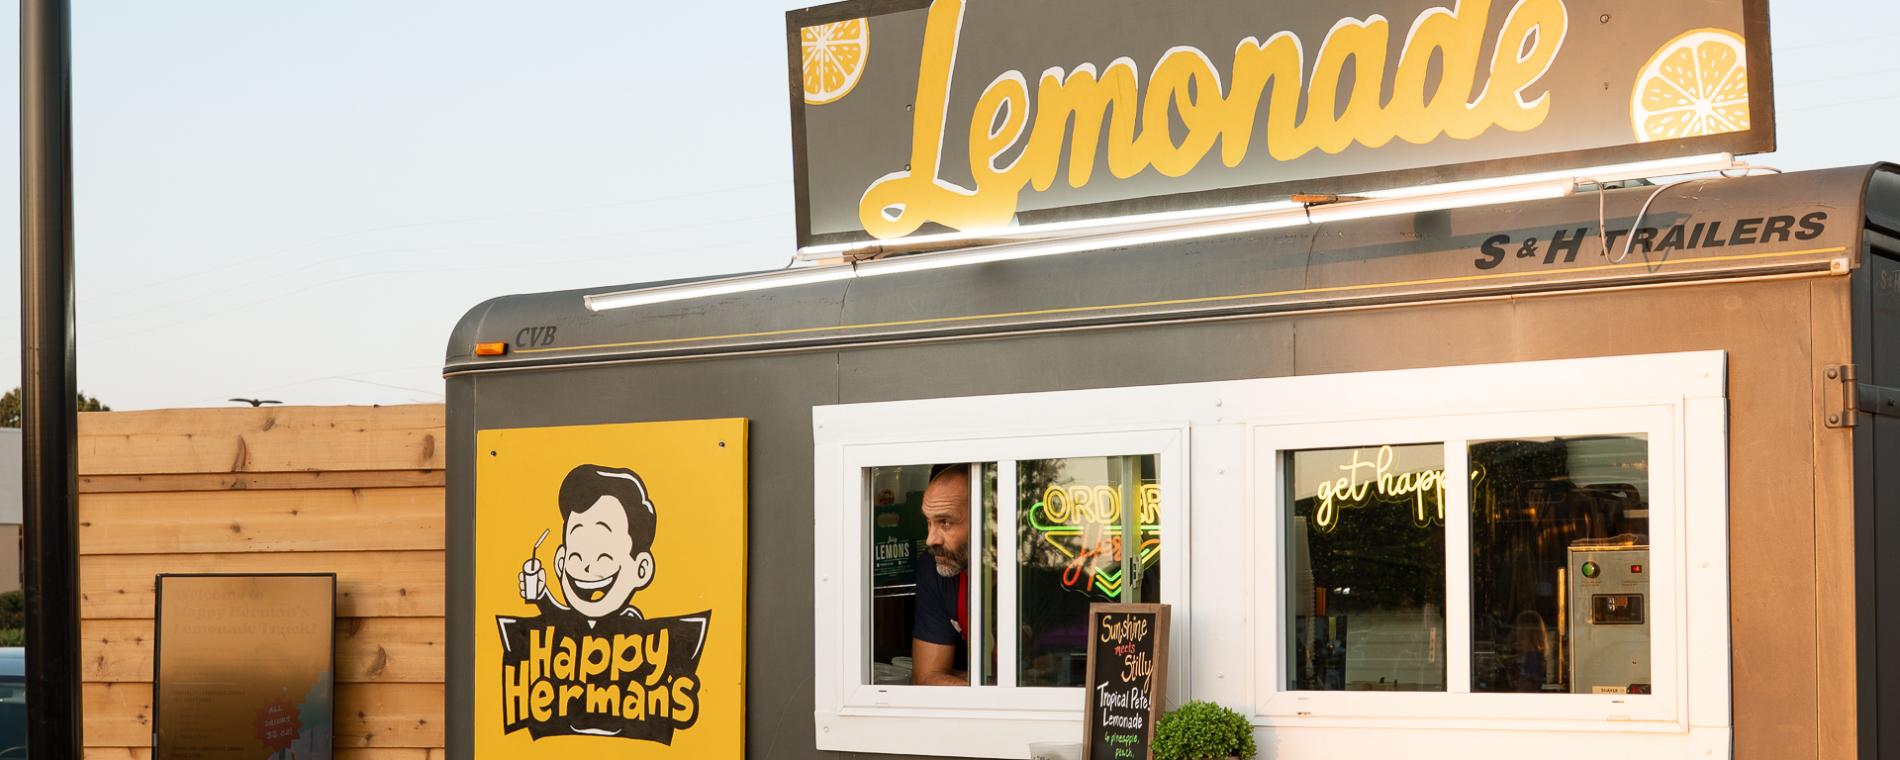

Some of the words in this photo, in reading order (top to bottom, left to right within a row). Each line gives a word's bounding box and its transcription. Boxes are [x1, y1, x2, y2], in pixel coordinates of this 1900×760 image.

[858, 0, 1568, 240] Lemonade
[1474, 234, 1511, 270] S
[1516, 237, 1539, 259] &
[1543, 228, 1588, 265] H
[1600, 211, 1828, 257] TRAILERS
[515, 326, 557, 348] CVB
[1317, 450, 1375, 526] get
[1377, 445, 1478, 520] happ
[1043, 484, 1160, 523] ORDR
[875, 542, 910, 560] LEMONS
[175, 606, 225, 620] Happy
[230, 604, 311, 618] Herman's
[174, 622, 257, 635] Lemonade
[1101, 614, 1148, 644] Sunshine
[530, 626, 670, 686] Happy
[1114, 642, 1136, 657] meets
[1121, 651, 1154, 694] Stilly
[505, 661, 694, 726] Herman's
[1097, 681, 1129, 711] Tropical
[1103, 707, 1143, 729] Lemonade
